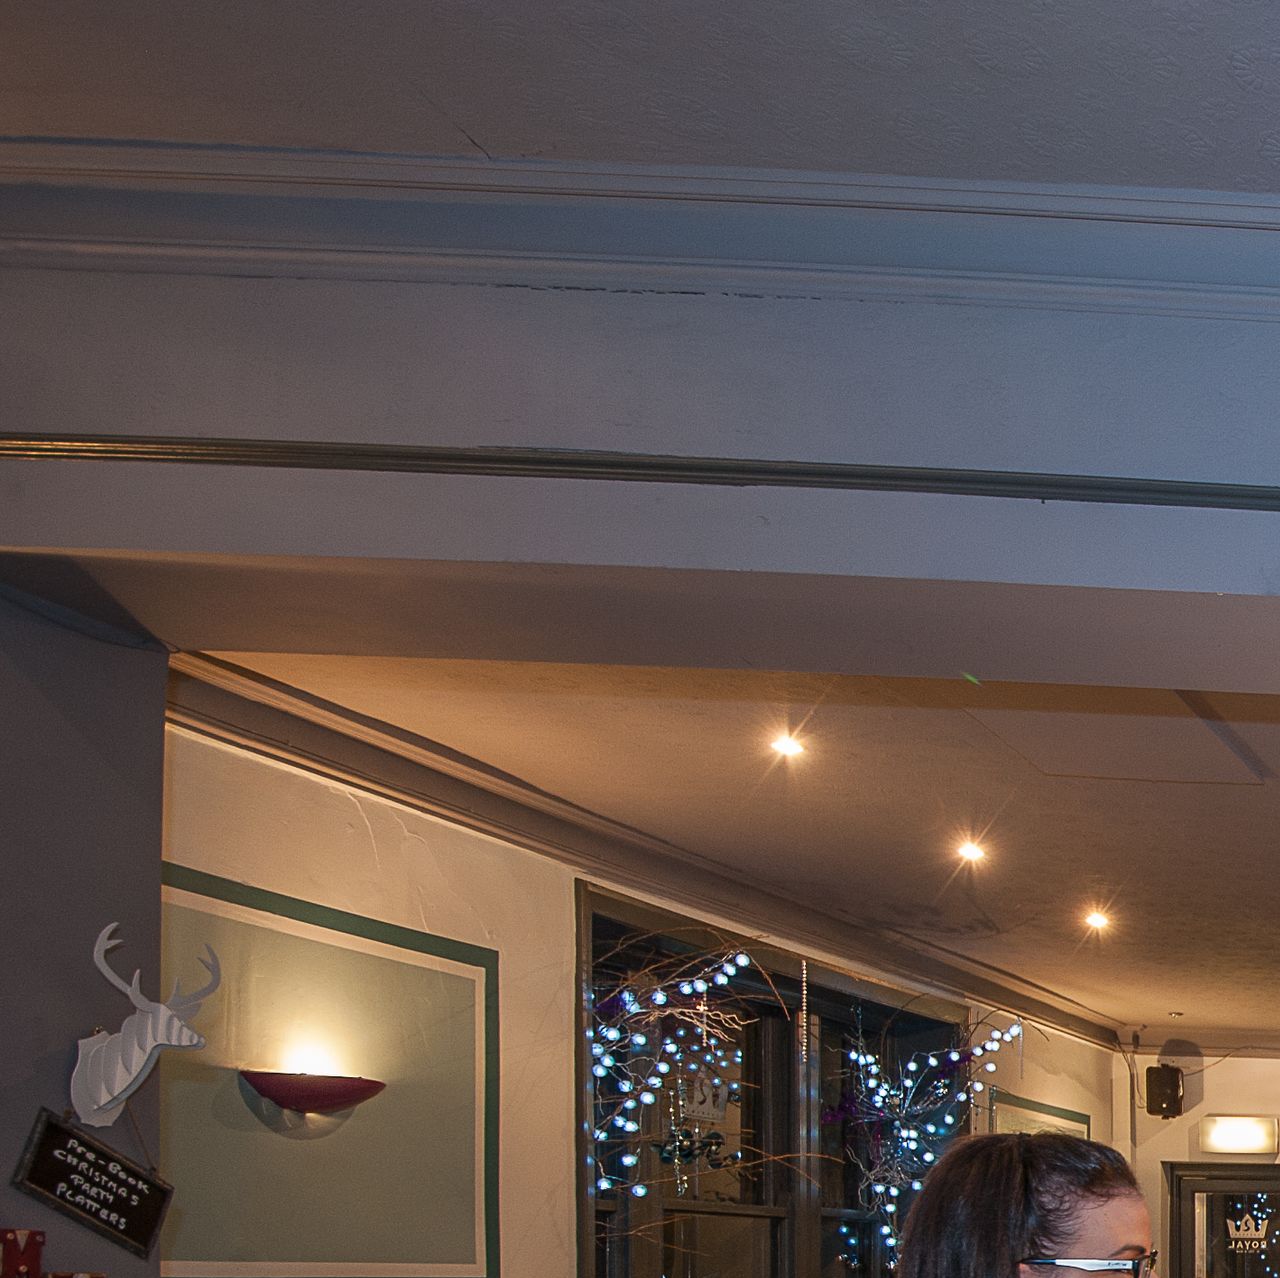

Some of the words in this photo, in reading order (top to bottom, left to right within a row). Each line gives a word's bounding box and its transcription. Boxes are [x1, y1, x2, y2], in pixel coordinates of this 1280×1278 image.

[53, 1149, 140, 1206] CHRISTMAS
[70, 1174, 114, 1204] PARTY
[56, 1182, 127, 1230] PLATTERS
